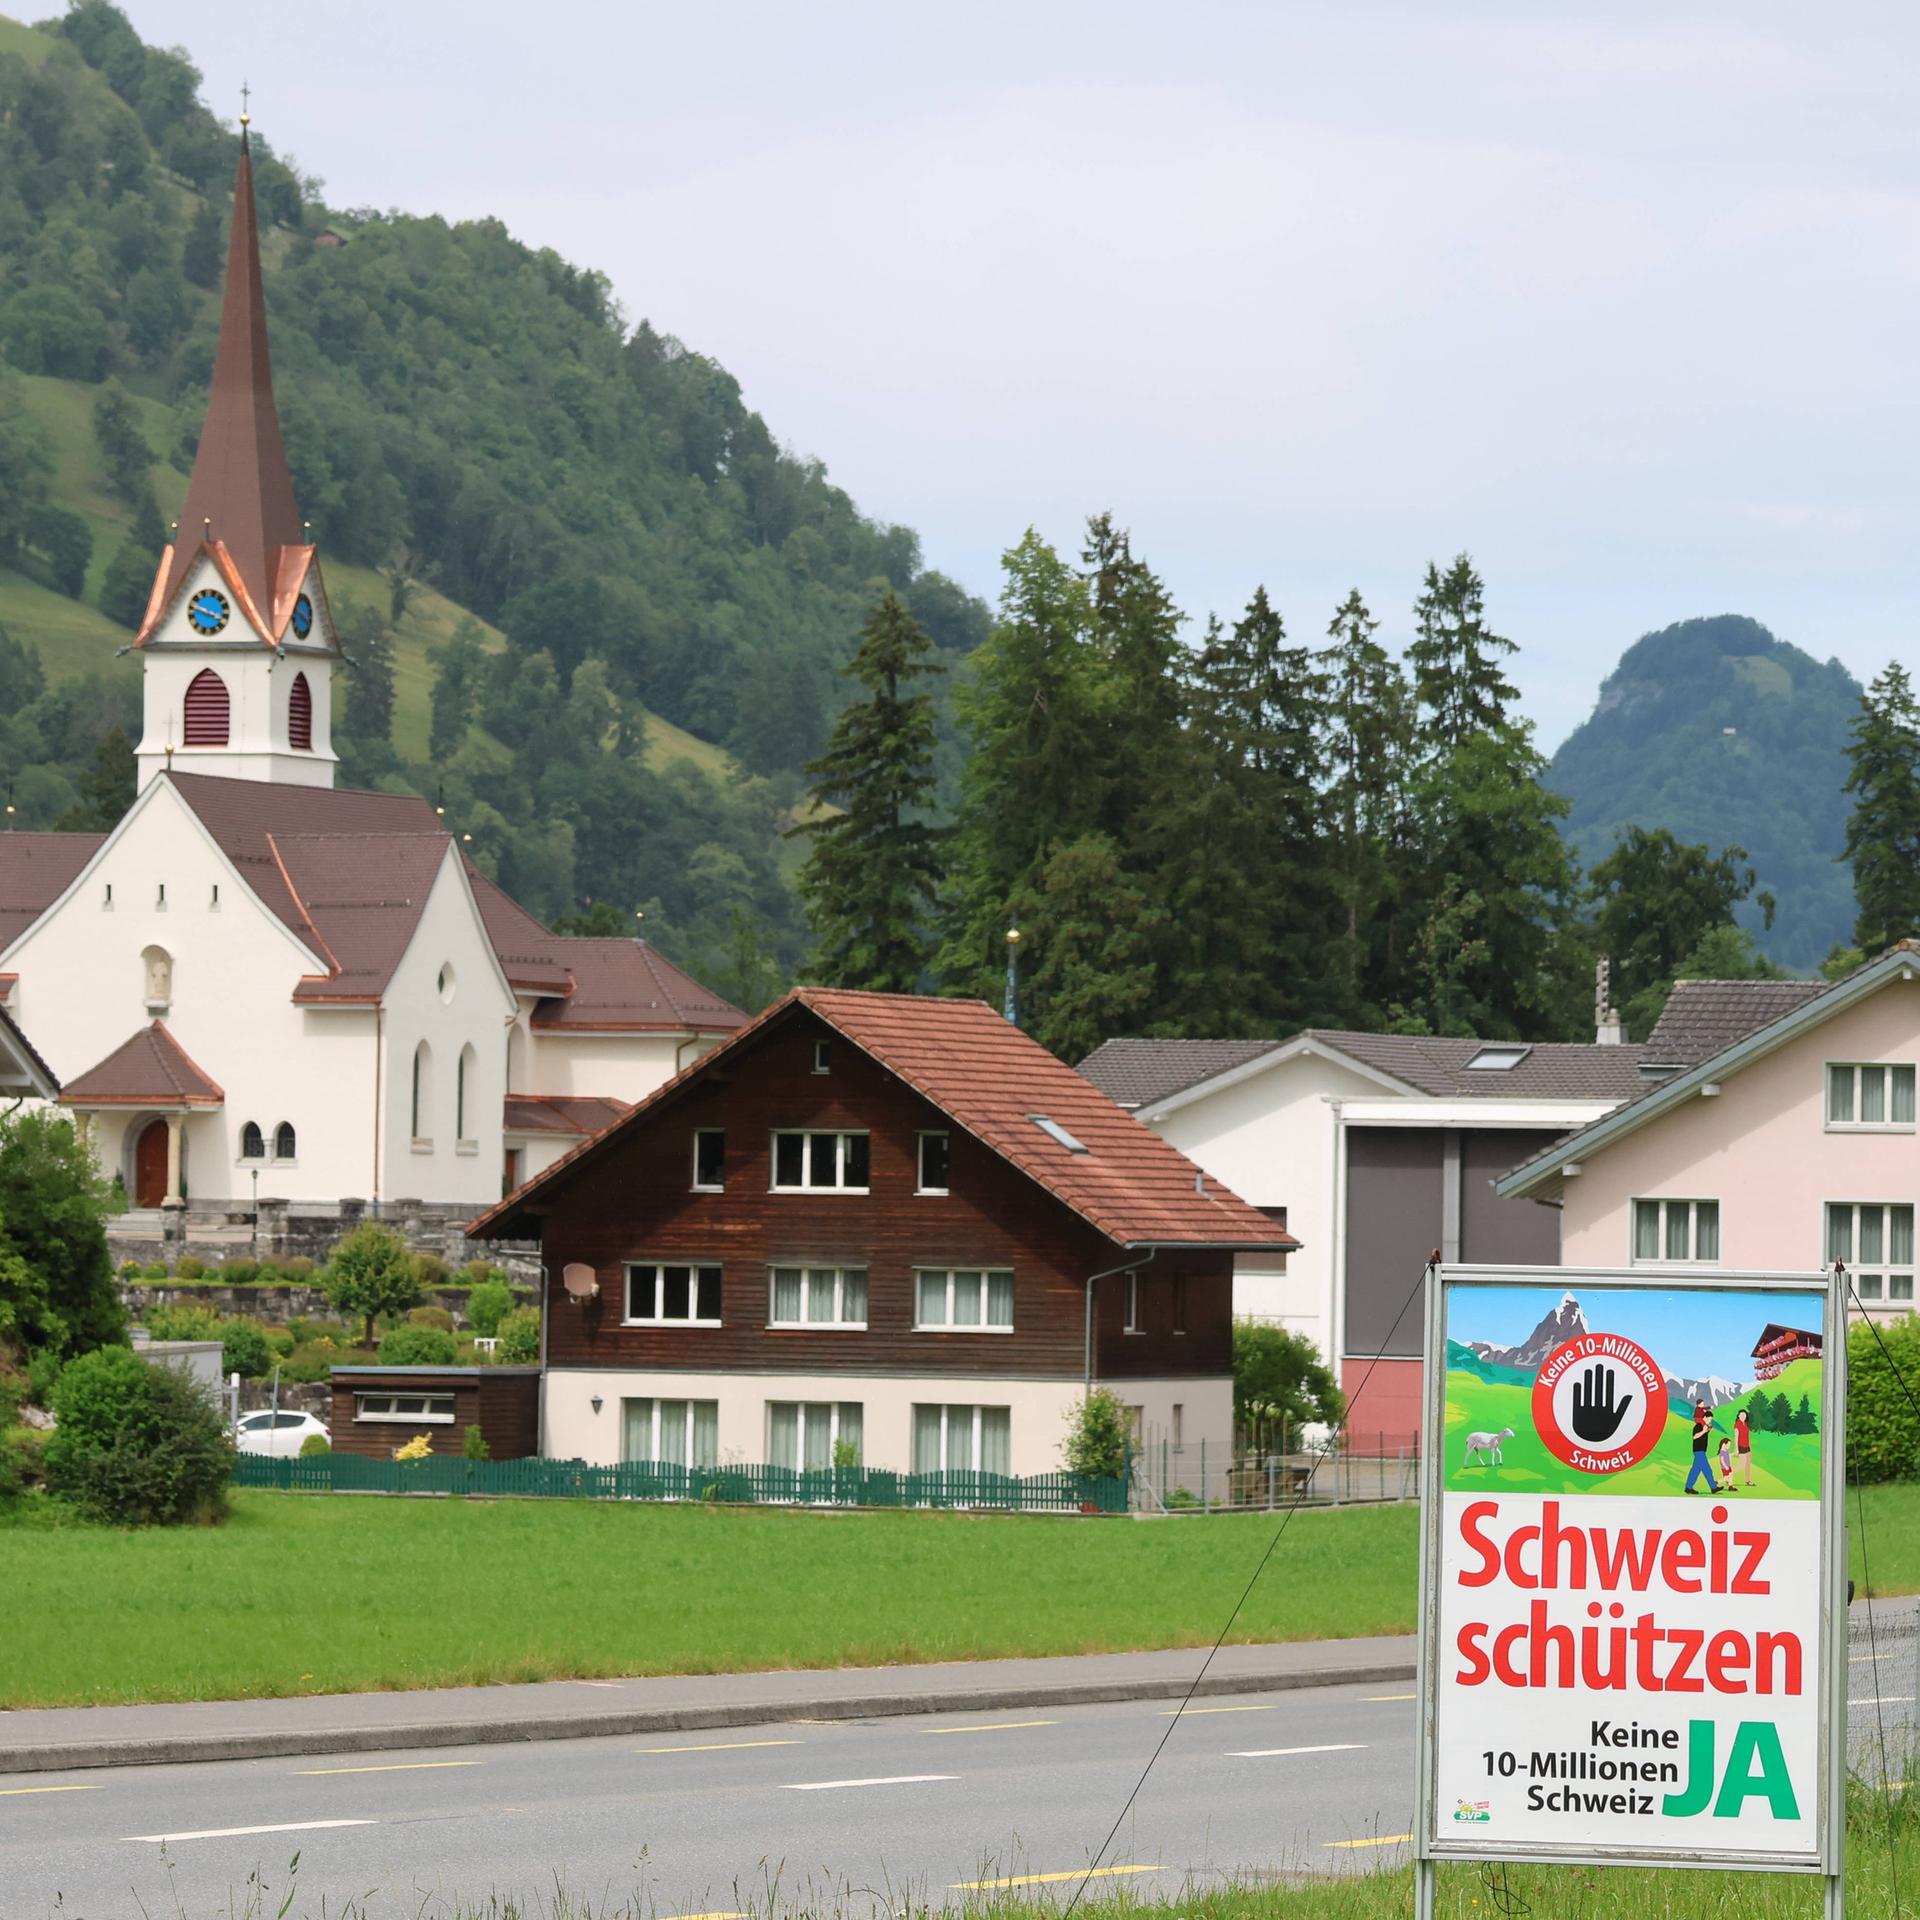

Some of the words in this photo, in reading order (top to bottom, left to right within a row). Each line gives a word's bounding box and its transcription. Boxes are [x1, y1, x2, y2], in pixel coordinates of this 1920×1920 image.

[1539, 1349, 1575, 1388] Keine
[1576, 1337, 1659, 1393] 10-Millionen
[1569, 1449, 1633, 1471] Schweiz
[1458, 1501, 1770, 1595] Schweiz
[1456, 1600, 1802, 1695] schützen
[1591, 1721, 1679, 1749] Keine
[1482, 1751, 1678, 1782] 10-Millionen
[1662, 1720, 1801, 1820] JA
[1527, 1785, 1654, 1815] Schweiz
[1460, 1812, 1482, 1820] SVP
